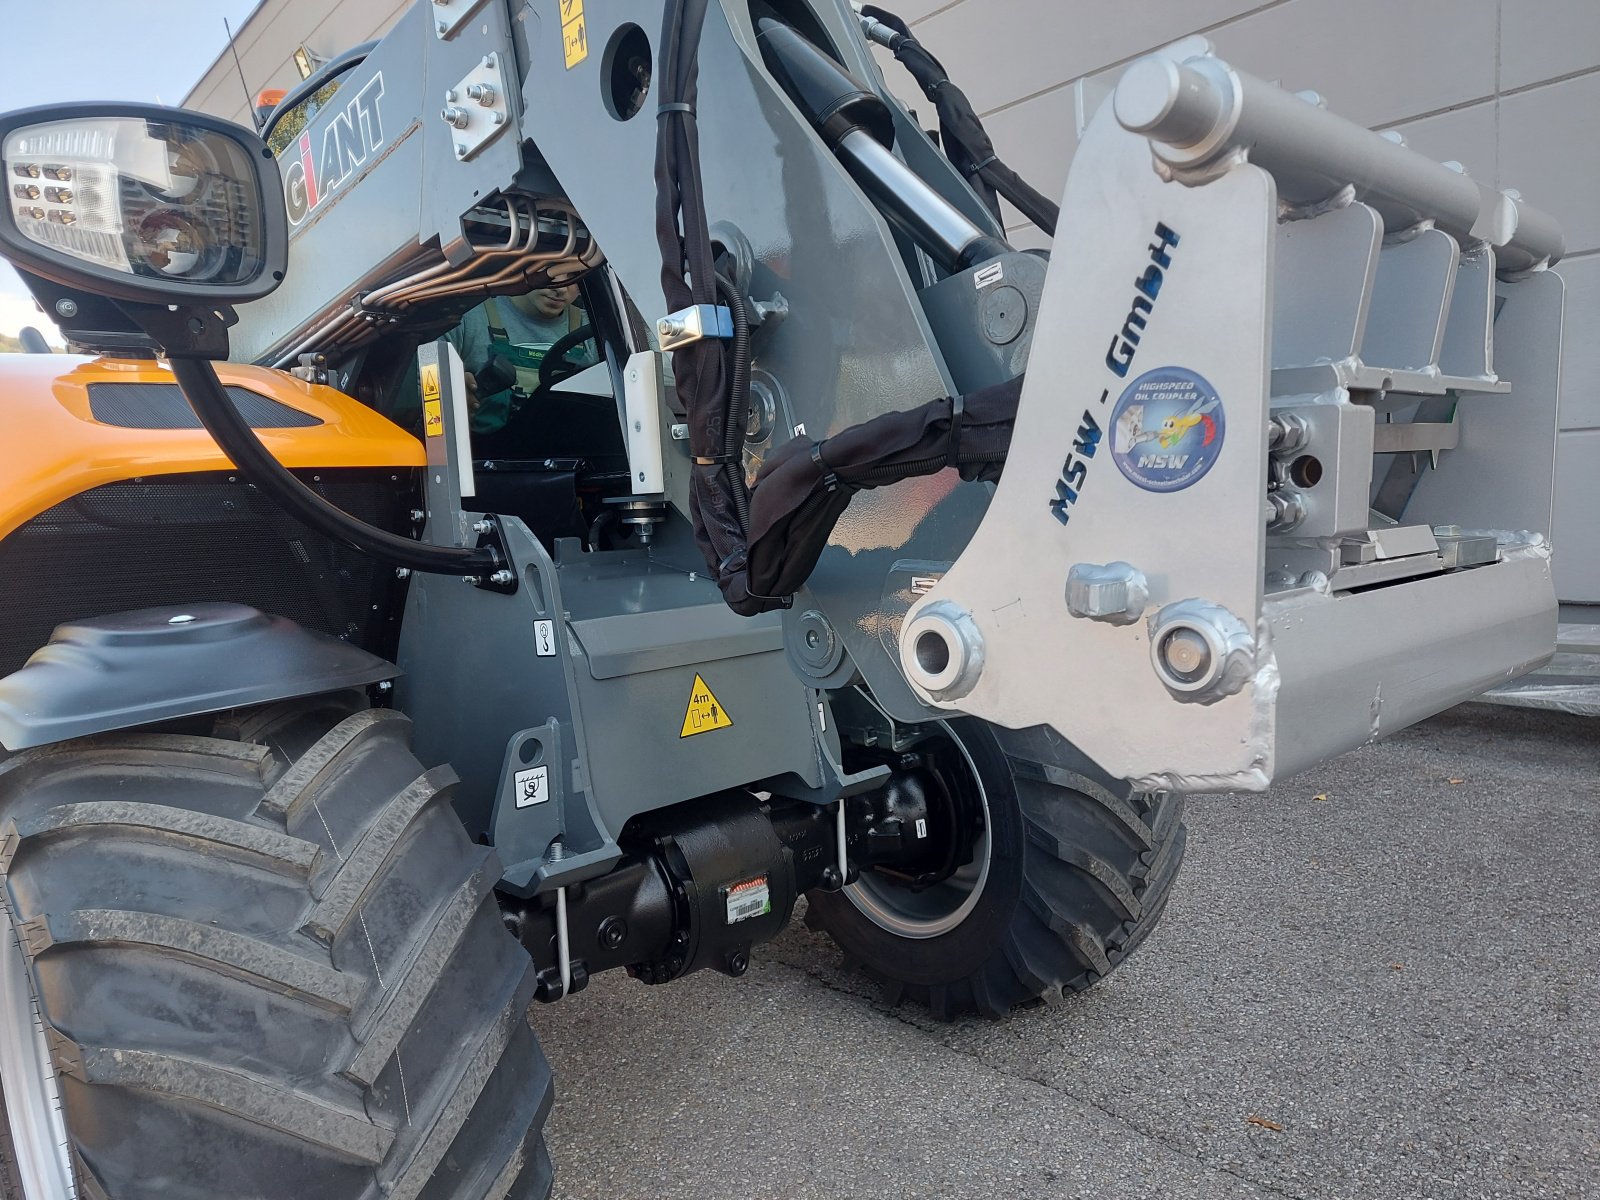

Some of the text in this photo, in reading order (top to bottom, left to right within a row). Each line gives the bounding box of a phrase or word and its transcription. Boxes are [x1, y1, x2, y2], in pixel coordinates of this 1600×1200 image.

[1049, 409, 1103, 526] MSW
[1105, 221, 1181, 378] GmbH
[1139, 382, 1195, 391] HIGHSPEED
[1152, 392, 1198, 400] COUPLER
[1137, 454, 1189, 469] MSW
[693, 693, 710, 704] 4m
